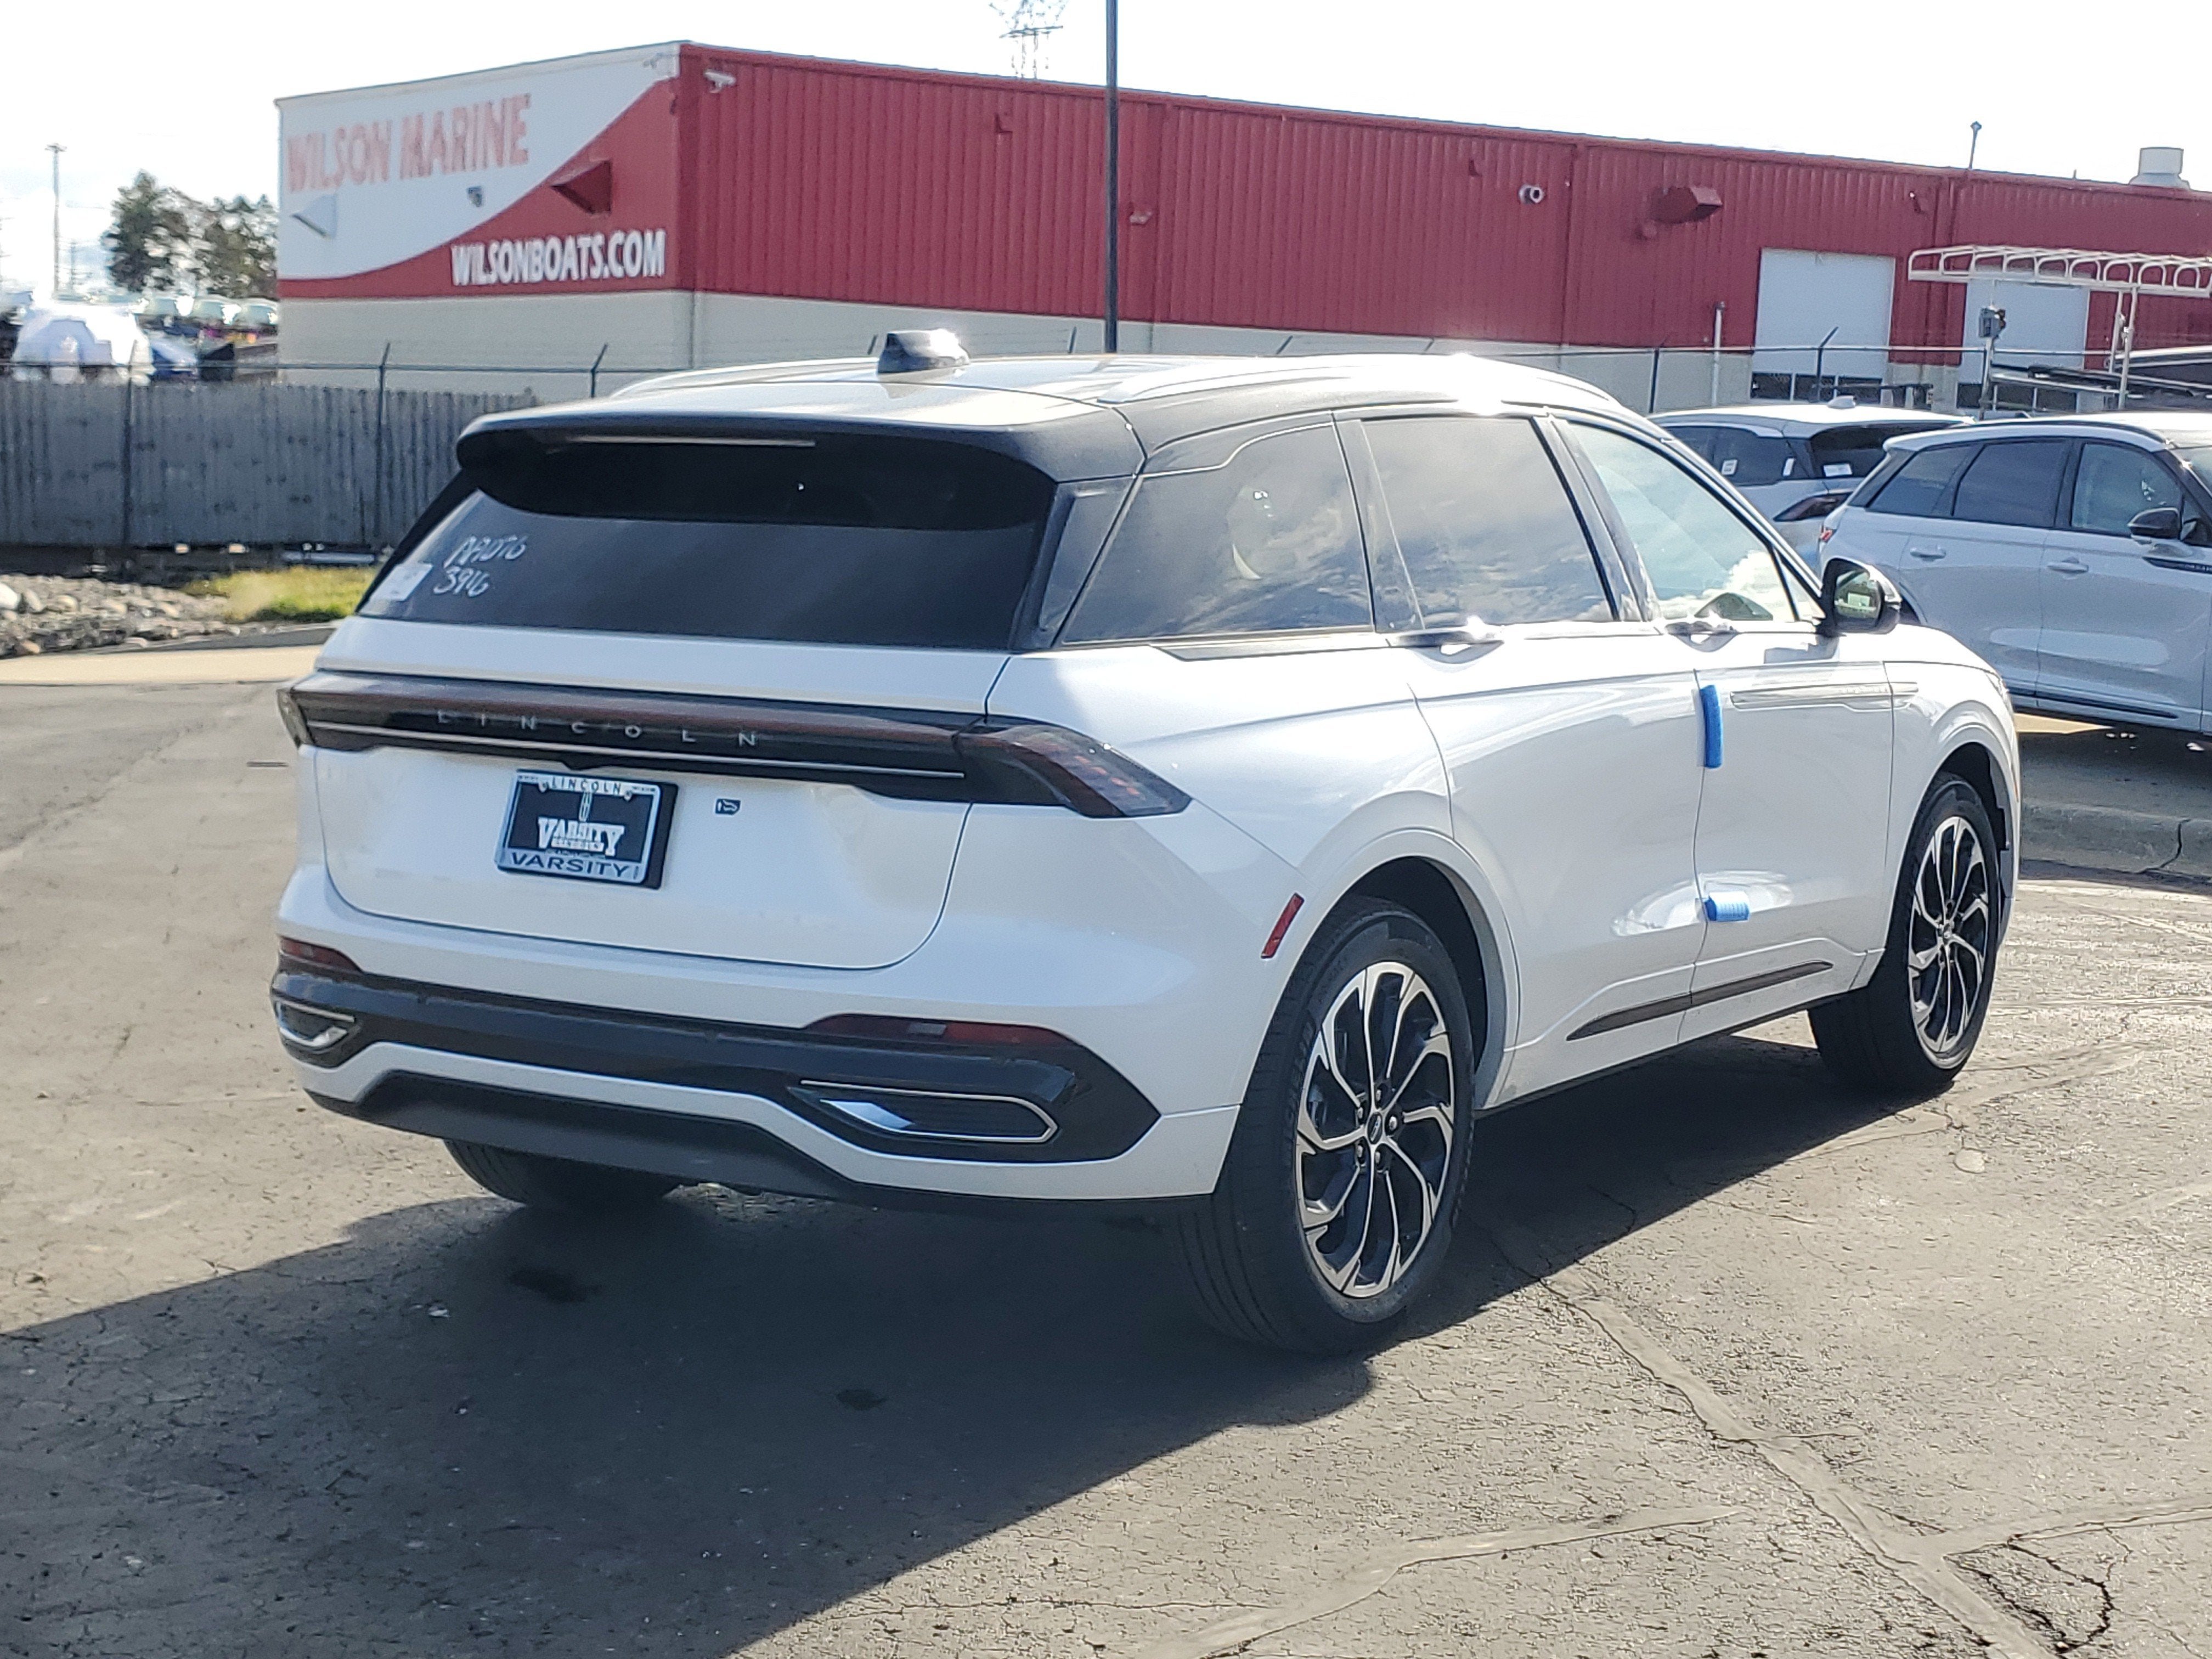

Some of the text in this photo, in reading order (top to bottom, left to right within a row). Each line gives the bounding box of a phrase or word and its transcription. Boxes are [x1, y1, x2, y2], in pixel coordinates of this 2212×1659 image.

[287, 93, 530, 193] WILSON MARINE
[450, 229, 667, 286] WILSONBOATS.COM
[437, 711, 756, 747] LINCOLN
[552, 776, 622, 794] LINCOLN
[511, 851, 629, 877] VARSITY
